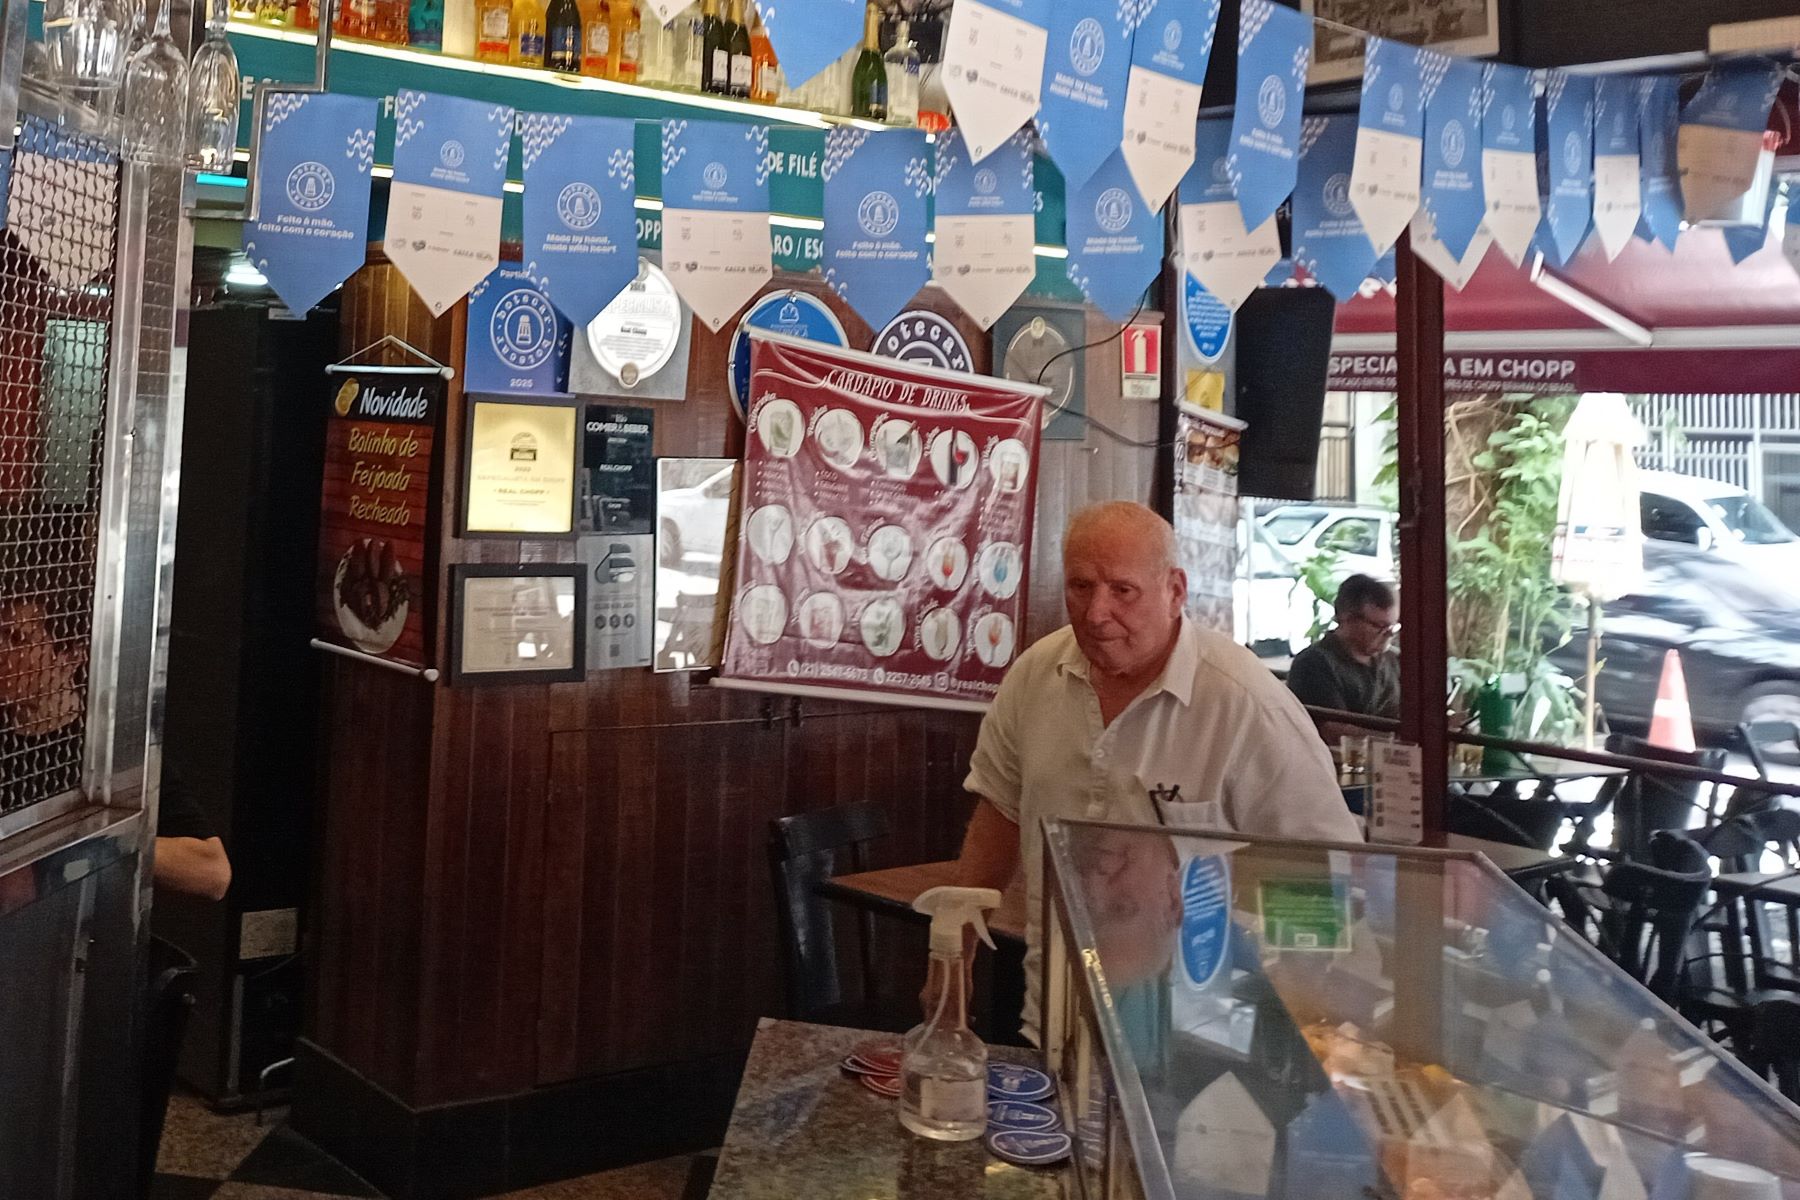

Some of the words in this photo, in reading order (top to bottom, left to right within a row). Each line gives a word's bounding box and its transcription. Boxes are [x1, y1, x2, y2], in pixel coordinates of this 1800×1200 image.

[788, 152, 817, 179] FILÉ
[277, 214, 301, 225] Feito
[887, 320, 966, 370] otecar
[510, 378, 534, 388] 2025
[1328, 356, 1398, 375] SPECIA
[1460, 359, 1493, 377] EM
[1498, 359, 1576, 379] CHOPP
[359, 386, 429, 419] Novidade
[826, 369, 895, 399] CARDÁPIO
[899, 383, 919, 404] DE
[921, 387, 968, 413] DRINKS
[348, 427, 397, 456] Bolinho
[398, 429, 419, 458] de
[352, 460, 412, 493] Feijoada
[349, 495, 411, 526] Recheado
